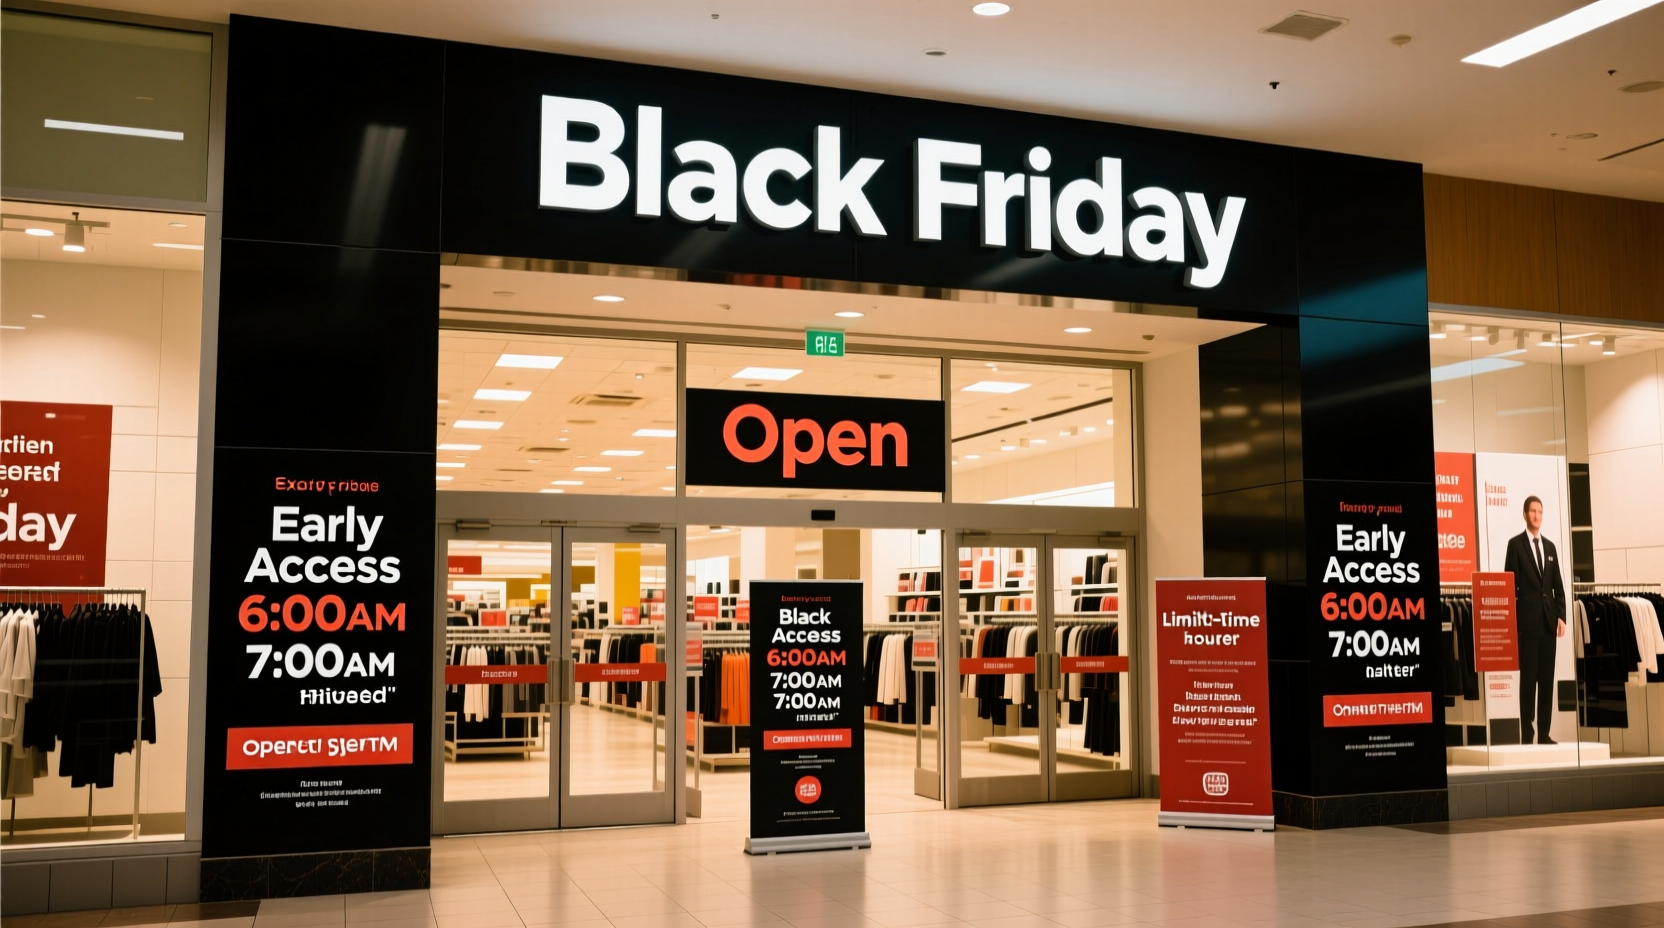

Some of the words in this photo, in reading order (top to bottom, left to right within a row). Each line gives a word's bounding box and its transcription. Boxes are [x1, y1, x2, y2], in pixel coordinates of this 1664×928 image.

[539, 95, 887, 236] Black
[913, 138, 1247, 288] Friday
[722, 403, 909, 479] Open
[271, 505, 384, 552] Early
[1335, 523, 1406, 560] Early
[243, 547, 401, 584] Access
[1322, 556, 1421, 584] Access
[238, 594, 406, 633] 6:00AM
[779, 607, 831, 626] Black
[1320, 592, 1426, 622] 6:00AM
[771, 628, 842, 644] Access
[1328, 630, 1421, 658] 7:00AM
[245, 642, 396, 679] 7:00AM
[766, 648, 847, 667] 6:00AM
[770, 672, 842, 690] 7:00AM
[773, 693, 841, 710] 7:00AM
